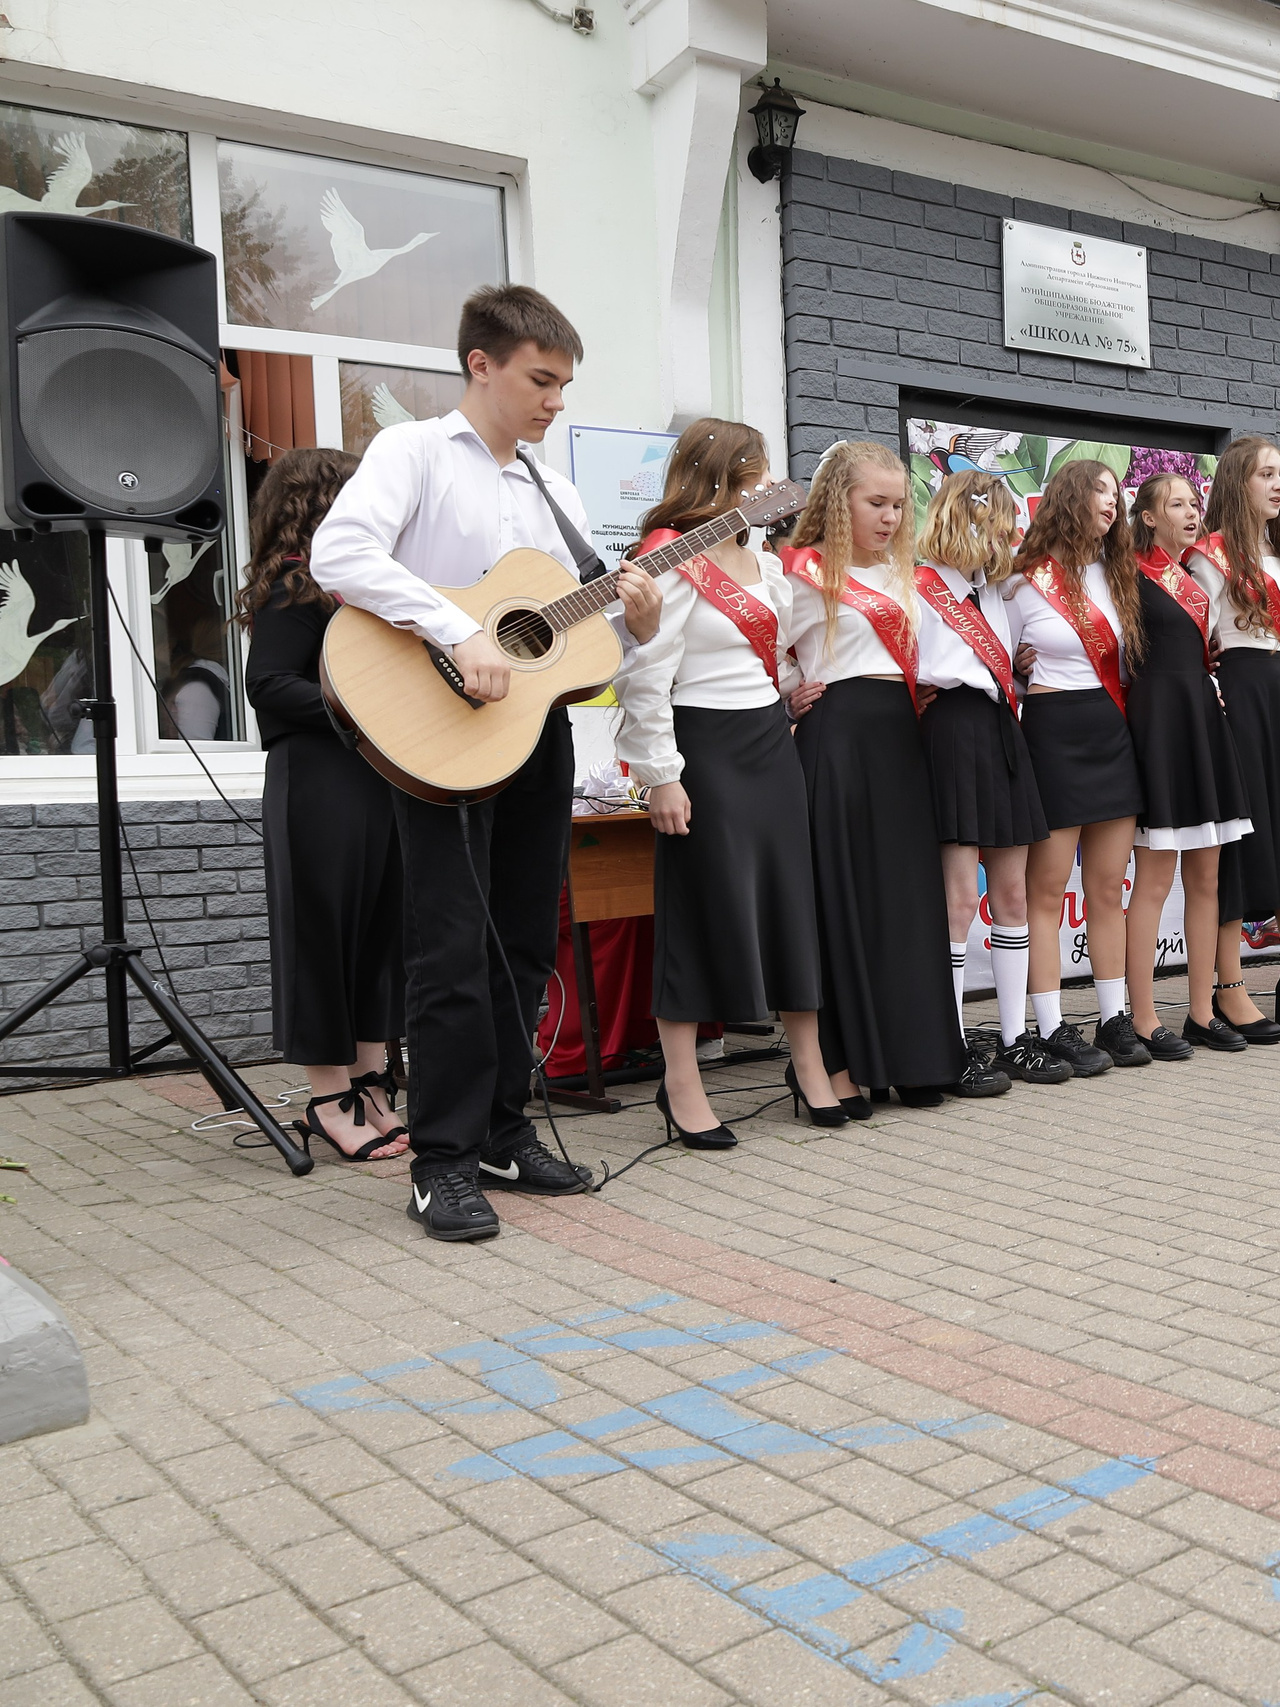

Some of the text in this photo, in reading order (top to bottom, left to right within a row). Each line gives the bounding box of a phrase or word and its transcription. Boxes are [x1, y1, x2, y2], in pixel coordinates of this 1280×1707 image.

[1020, 286, 1135, 313] МУНИЦИПАЛЬНОЕ БЮДЖЕТНОЕ
[1034, 297, 1124, 320] ОБЩЕОБРАЗОВАТЕЛЬНОЕ
[1055, 310, 1105, 325] УЧРЕЖДЕНИЕ
[1020, 323, 1138, 354] «ШКОЛА № 75»
[926, 579, 1008, 677] Выпускница
